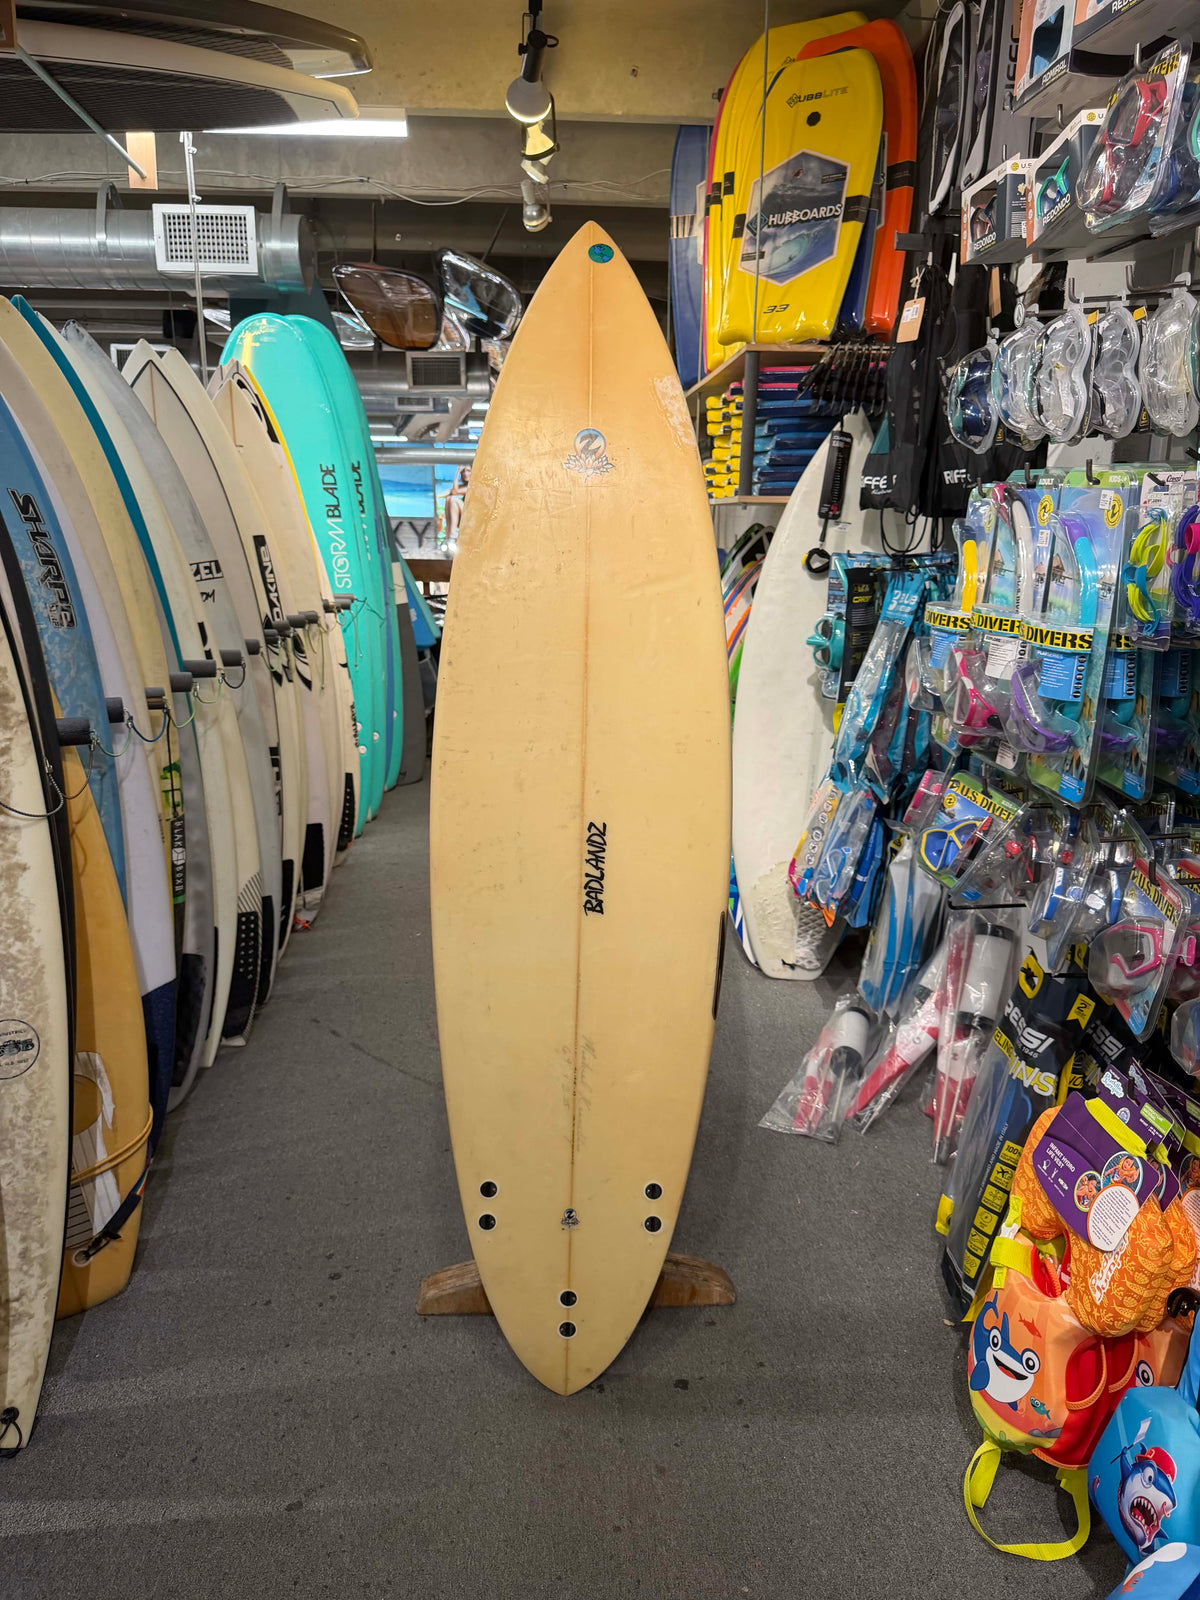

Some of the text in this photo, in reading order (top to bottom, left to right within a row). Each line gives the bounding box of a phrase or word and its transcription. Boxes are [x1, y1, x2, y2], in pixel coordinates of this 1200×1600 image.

[1041, 59, 1067, 86] ADMIRAL
[768, 203, 842, 227] HUBBOARDS
[1042, 193, 1071, 226] REDONDO
[973, 232, 997, 251] REDONDO
[764, 304, 789, 314] 33
[1038, 477, 1054, 486] ADULT
[260, 546, 284, 621] DAKINE
[1026, 625, 1093, 650] DIVERS
[960, 784, 980, 804] U.S.
[583, 821, 607, 916] BADLANDZ
[1008, 1055, 1057, 1097] INS
[1046, 1147, 1065, 1169] LIFE VEST
[1049, 1142, 1076, 1173] INFANT HYDRO
